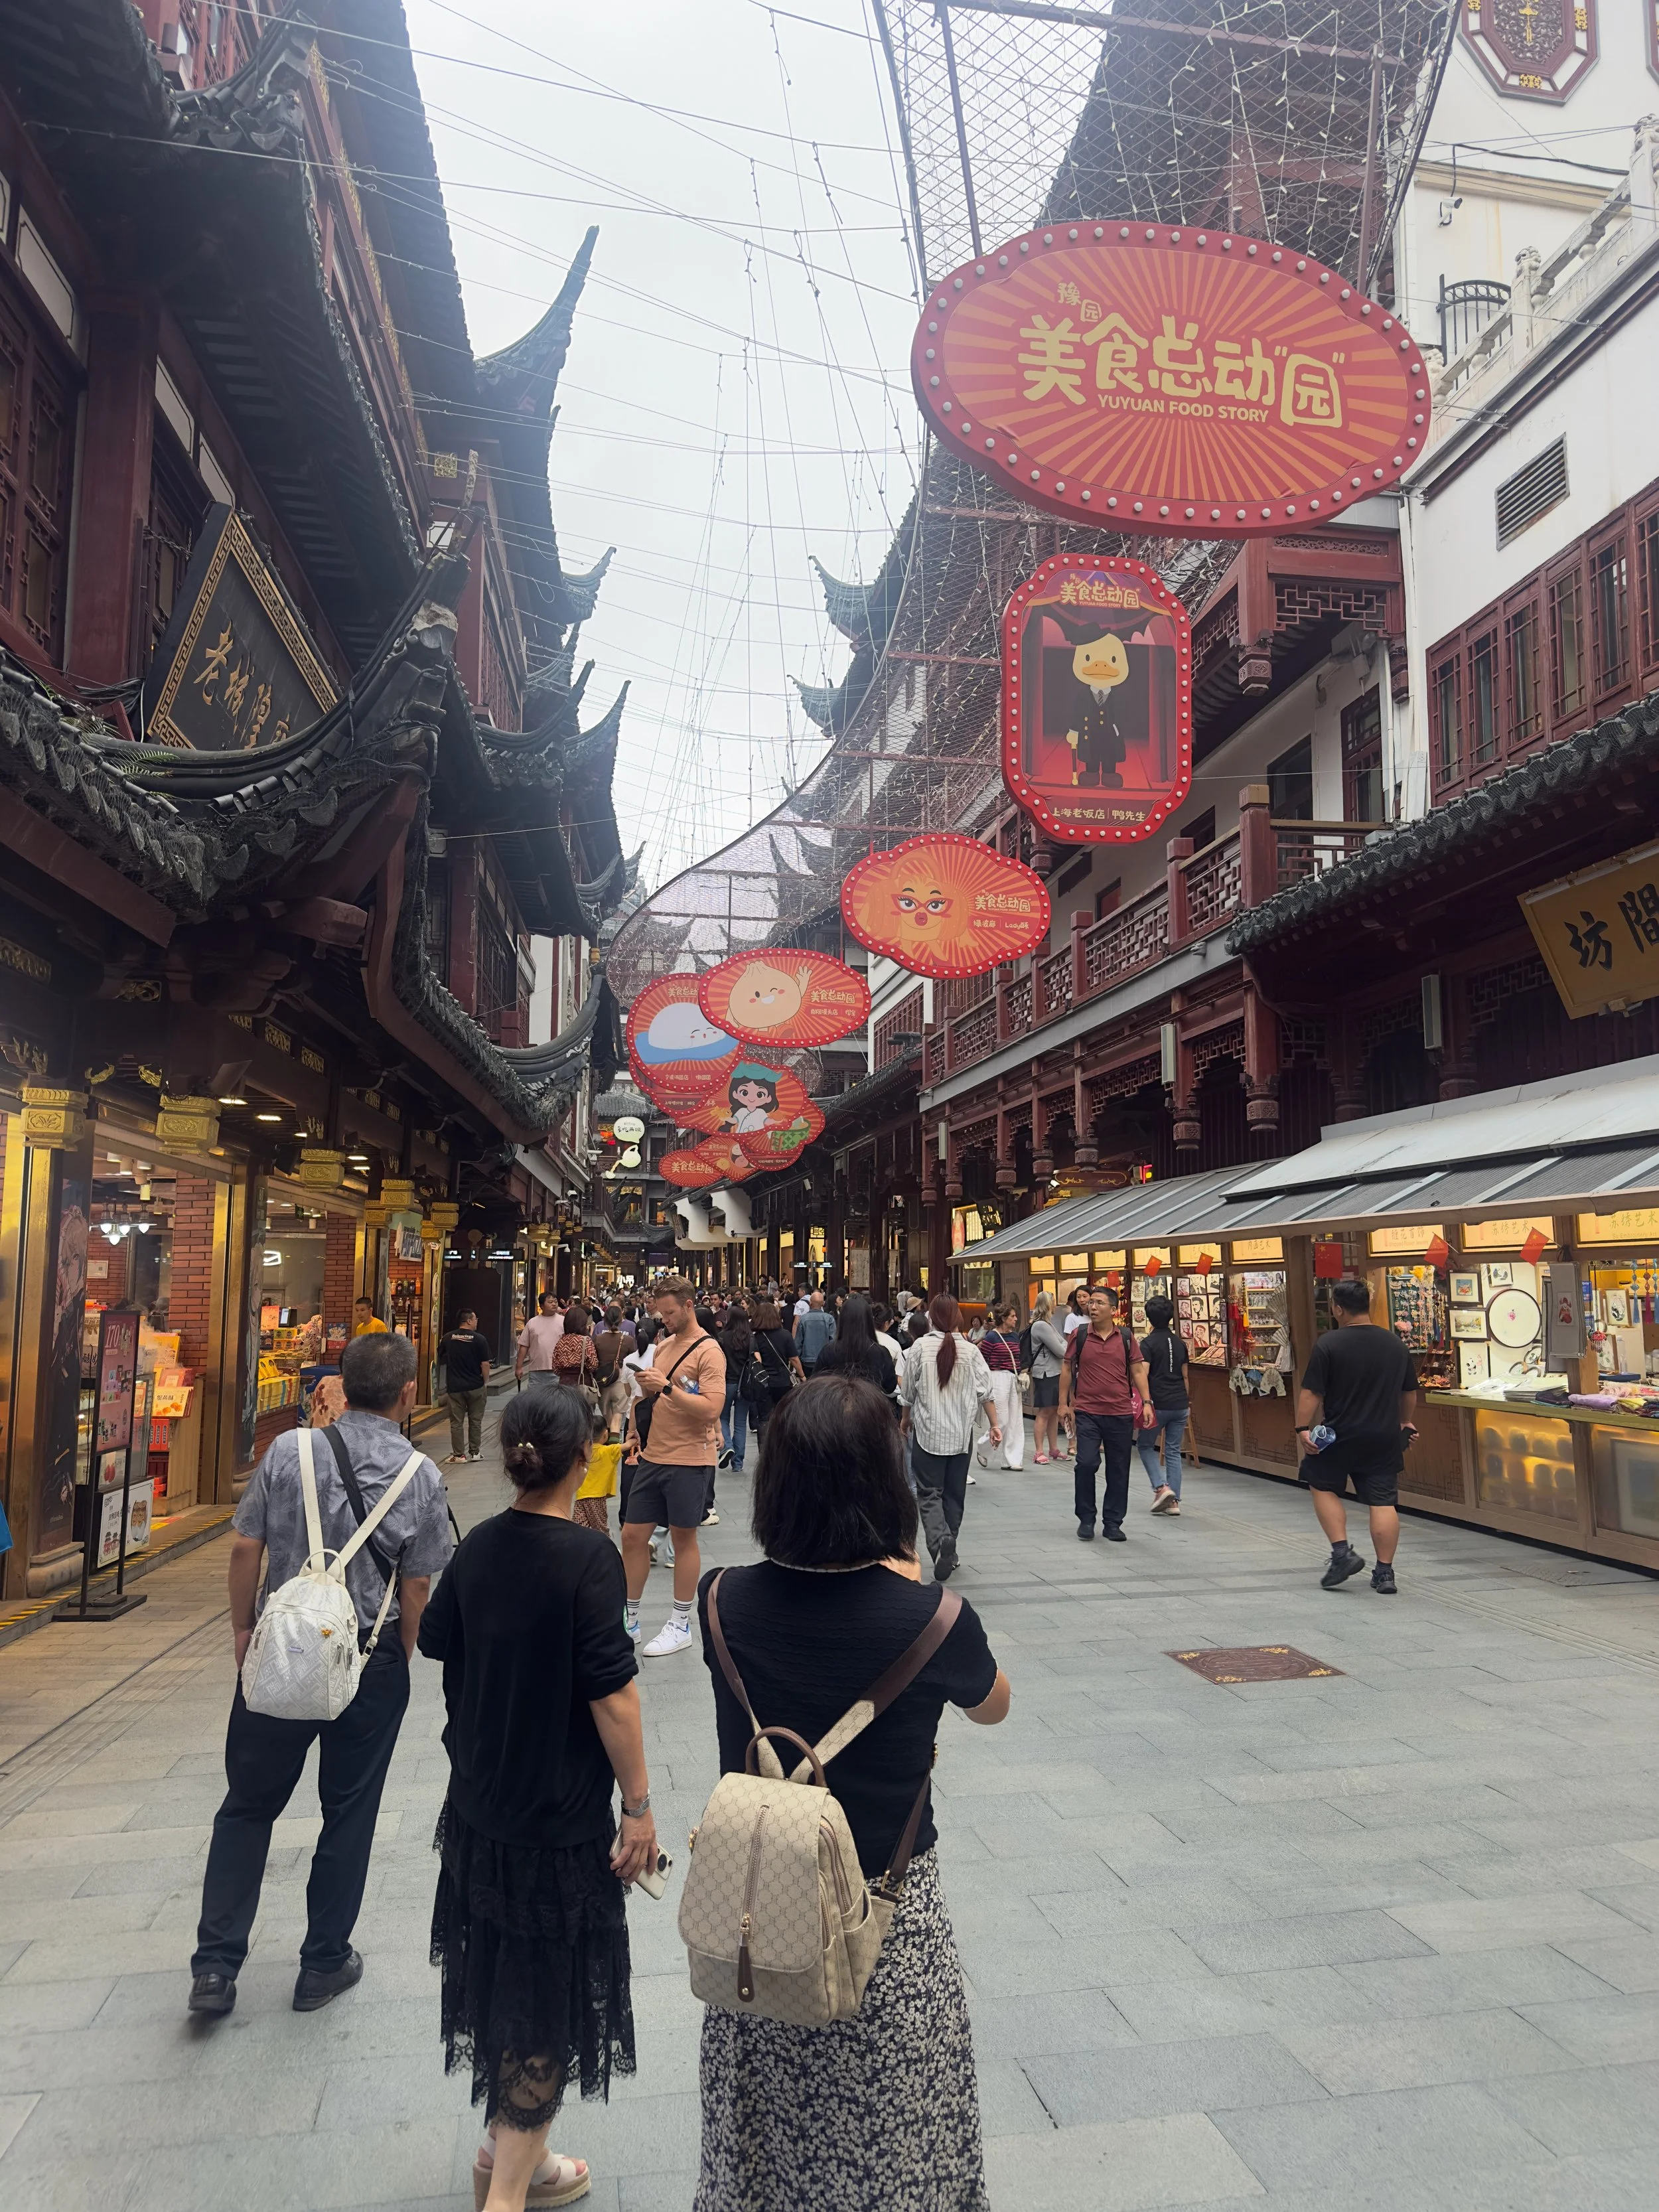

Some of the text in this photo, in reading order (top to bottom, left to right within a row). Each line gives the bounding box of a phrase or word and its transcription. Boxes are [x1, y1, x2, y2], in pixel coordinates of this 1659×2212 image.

[1098, 394, 1269, 423] YUYUAN FOOD STORY
[1052, 807, 1145, 822] 上海老饭店 鸭先生
[973, 919, 996, 928] 绿波廊
[1610, 1211, 1658, 1228] 苏绣艺术
[1491, 1220, 1530, 1236] 苏绣艺术
